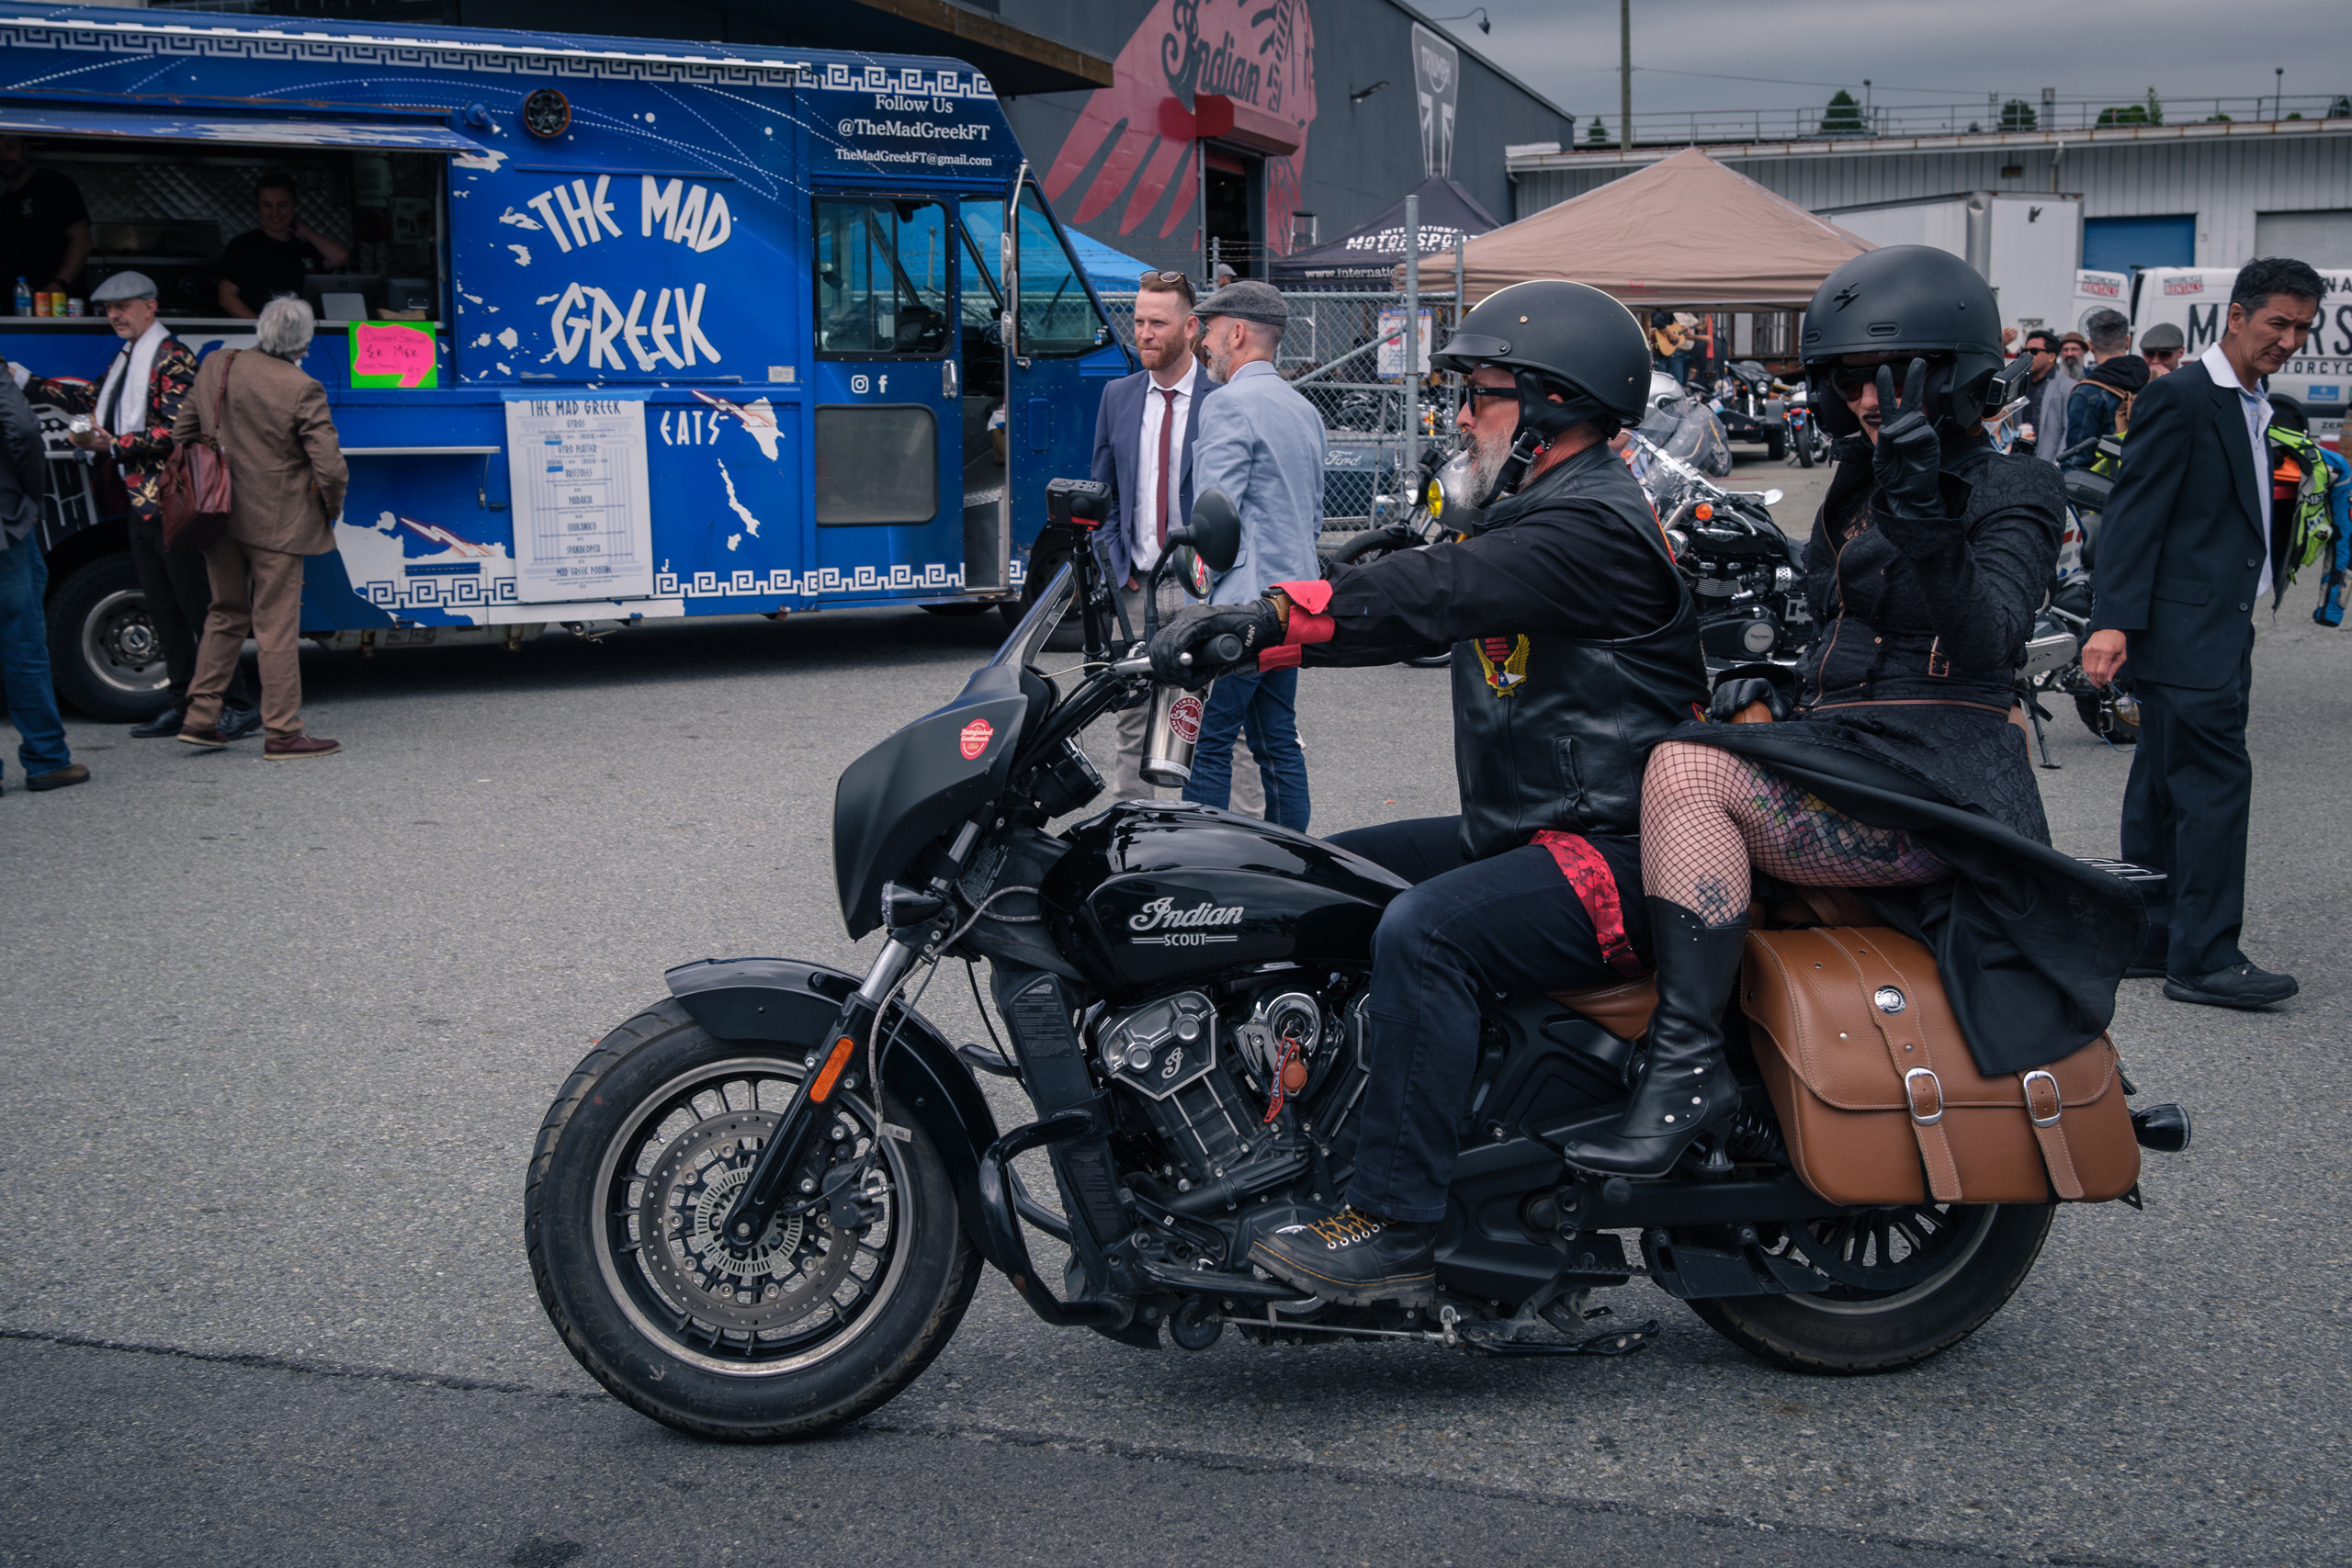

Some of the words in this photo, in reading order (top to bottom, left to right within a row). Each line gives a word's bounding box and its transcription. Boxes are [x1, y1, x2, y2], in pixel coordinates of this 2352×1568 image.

[1161, 0, 1261, 107] Indian
[875, 94, 929, 112] Follow
[933, 97, 954, 114] Us
[837, 118, 990, 141] @TheMadGreekFT
[834, 148, 992, 166] TheMadGreekFT@gmail.com
[527, 174, 624, 254] THE
[641, 174, 731, 254] MAD
[2082, 281, 2119, 298] RENTALS
[2165, 282, 2203, 295] RENTALS
[551, 282, 722, 372] GREEK
[529, 400, 551, 416] THE
[556, 400, 579, 416] MAD
[584, 400, 621, 415] GREEK
[567, 419, 586, 428] GYROS
[660, 411, 720, 446] EATS
[1324, 450, 1363, 466] Ford
[1129, 897, 1244, 931] Indian
[1164, 933, 1206, 946] SCOUT
